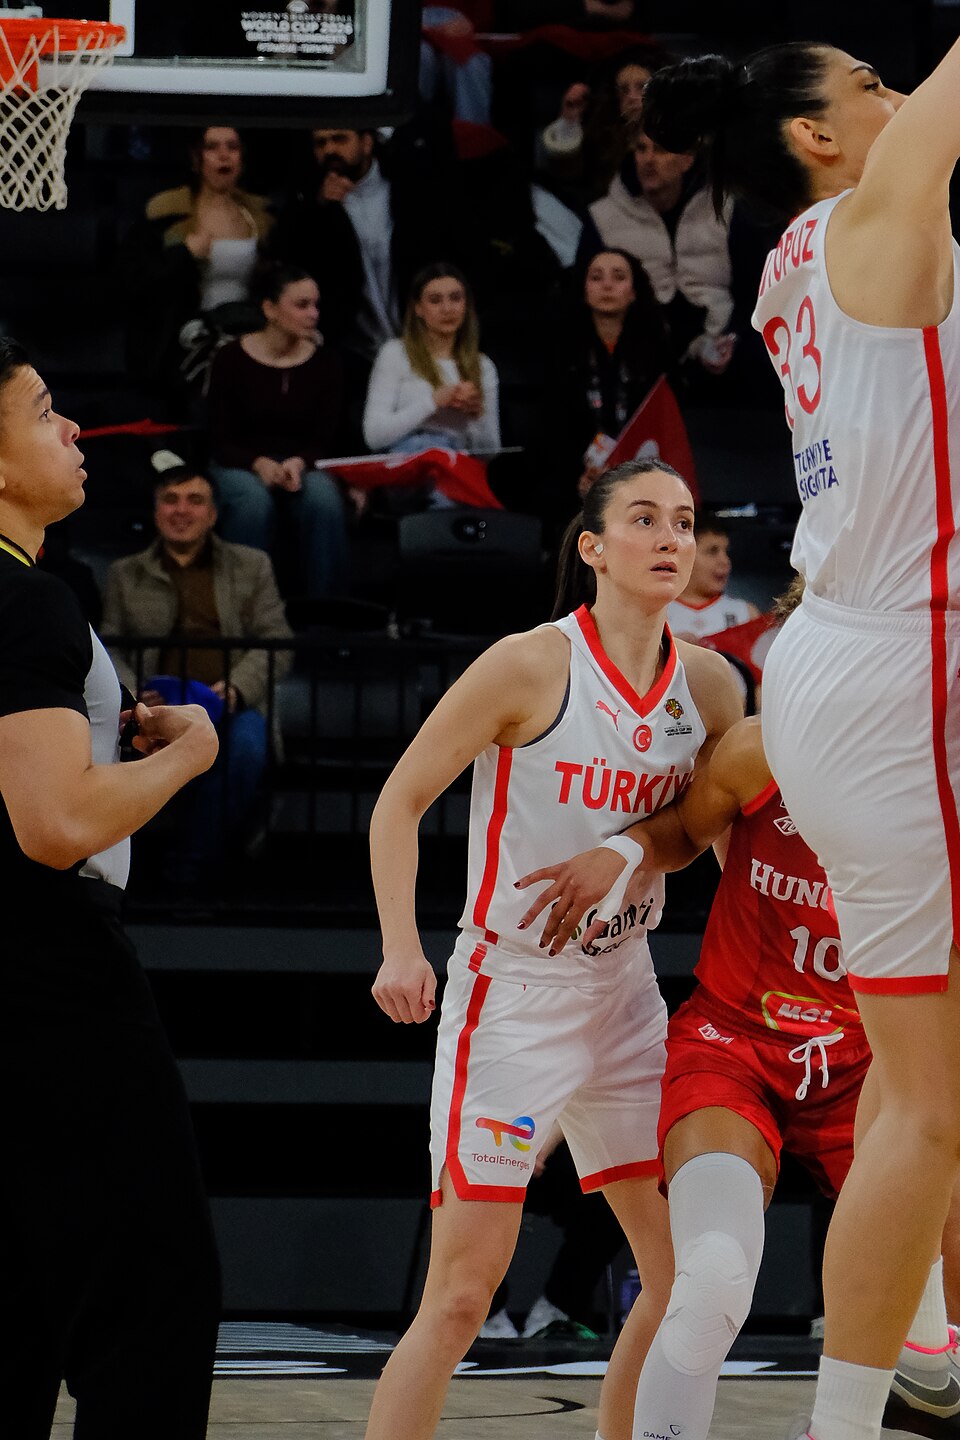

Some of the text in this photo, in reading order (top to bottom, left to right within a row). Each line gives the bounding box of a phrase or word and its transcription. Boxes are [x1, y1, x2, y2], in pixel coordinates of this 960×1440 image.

[763, 295, 822, 429] 33
[555, 757, 695, 814] TÜRKİY
[789, 925, 848, 982] 10
